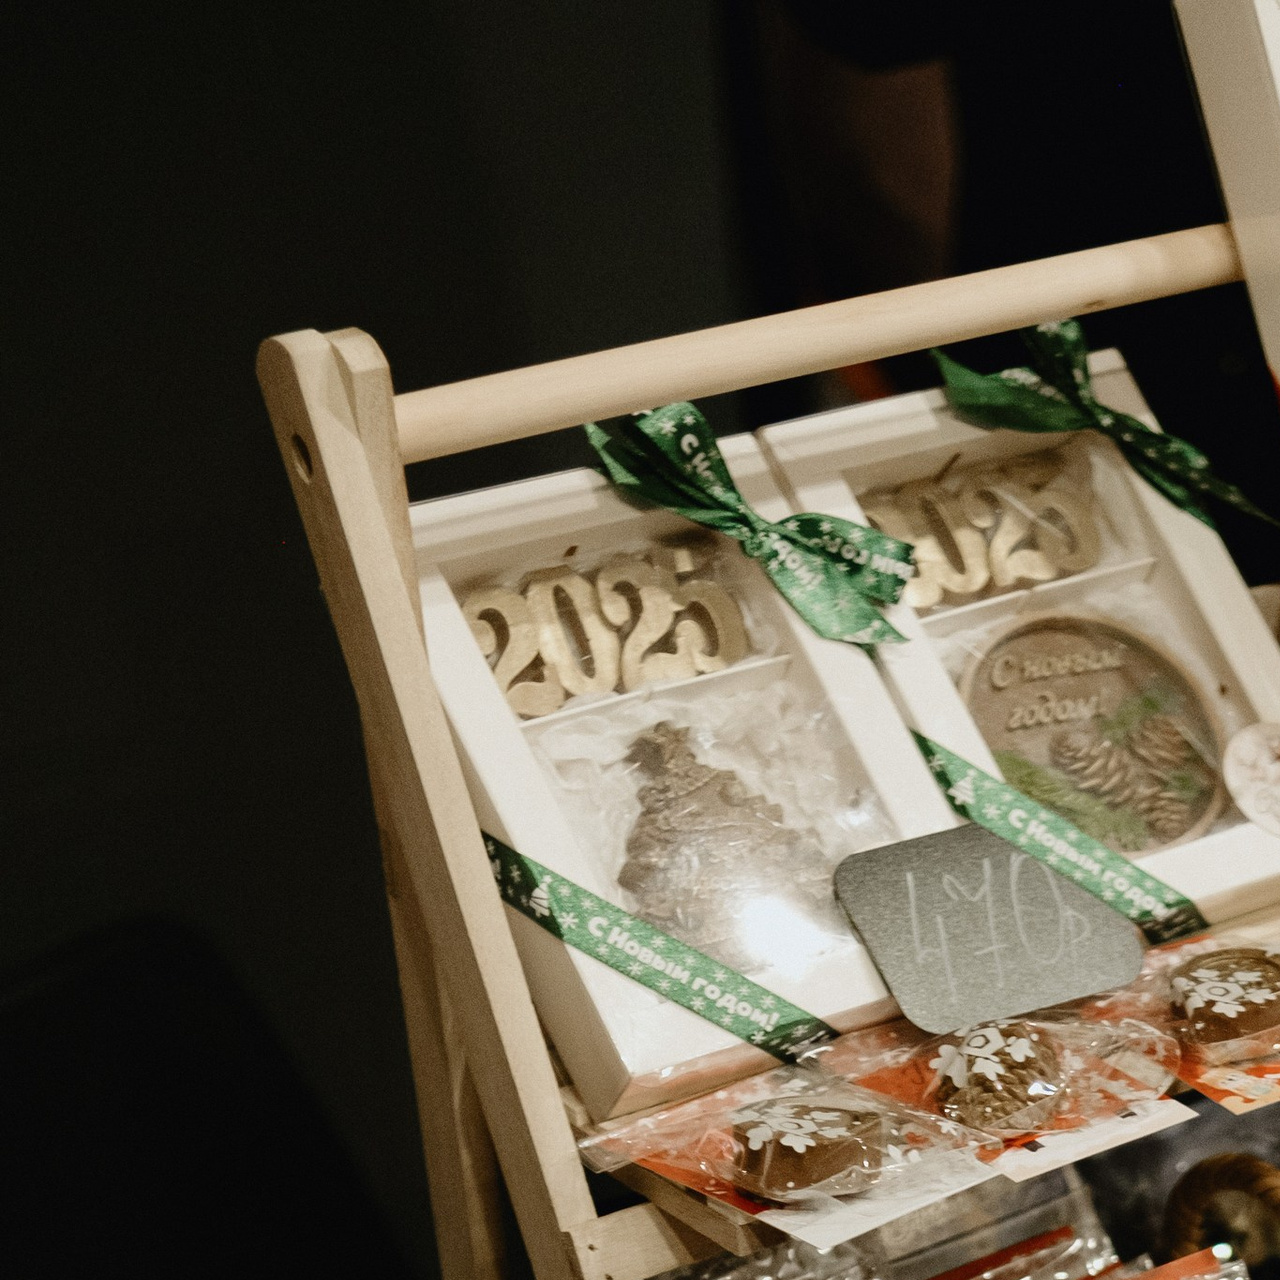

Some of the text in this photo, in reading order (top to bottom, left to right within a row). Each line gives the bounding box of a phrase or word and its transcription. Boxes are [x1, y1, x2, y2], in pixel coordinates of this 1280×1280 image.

[586, 916, 781, 1033] С Новым годом!
